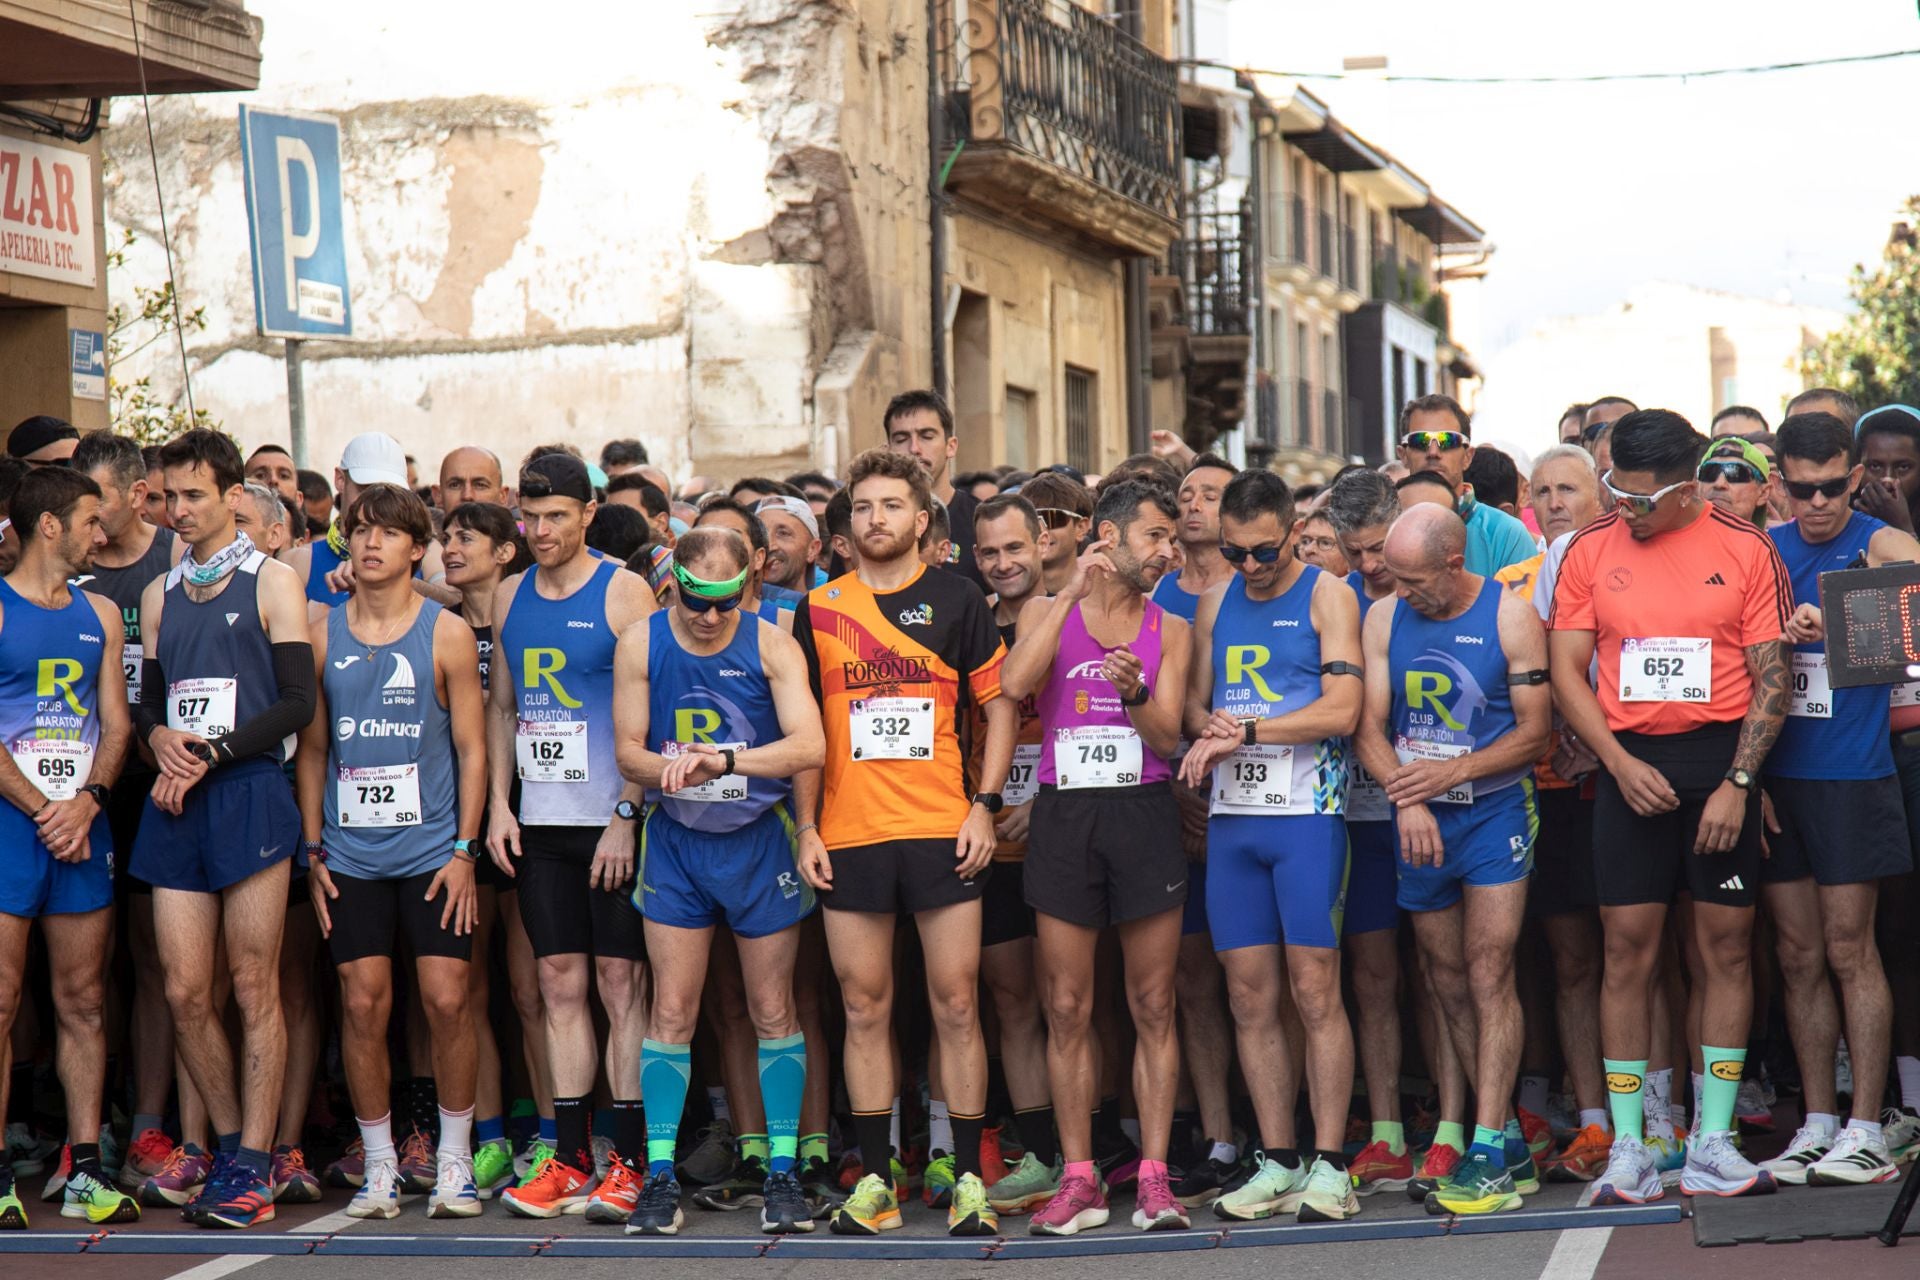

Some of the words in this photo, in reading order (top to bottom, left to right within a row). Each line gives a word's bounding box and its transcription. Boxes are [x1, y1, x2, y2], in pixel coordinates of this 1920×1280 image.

[0, 150, 80, 236] ZAR
[276, 135, 320, 311] P
[0, 230, 51, 266] APELERIA
[843, 658, 930, 683] FORONDA
[1225, 644, 1284, 702] R
[1643, 657, 1685, 677] 652
[36, 658, 89, 717] R
[523, 647, 584, 709] R
[383, 697, 394, 705] La
[394, 696, 415, 706] Rioja
[524, 693, 550, 706] CLUB
[1225, 688, 1251, 701] CLUB
[1405, 670, 1466, 730] R
[1682, 687, 1706, 699] SDi
[37, 701, 62, 713] CLUB
[178, 697, 210, 718] 677
[524, 706, 572, 721] MARATÓN
[1225, 701, 1271, 715] MARATÓN
[1807, 702, 1828, 714] SDi
[35, 714, 83, 728] MARATÓN
[359, 718, 421, 739] Chiruca
[872, 717, 911, 736] 332
[1409, 712, 1435, 726] CLUB
[1409, 726, 1455, 742] MARATÓN
[530, 741, 564, 760] 162
[1078, 744, 1118, 764] 749
[38, 758, 75, 777] 695
[564, 769, 586, 780] SDi
[1009, 764, 1033, 783] 07
[1233, 762, 1268, 783] 133
[1116, 771, 1139, 784] SDi
[357, 784, 396, 805] 732
[722, 788, 744, 800] SDi
[1265, 793, 1287, 805] SDi
[1446, 790, 1469, 802] SDi
[395, 811, 418, 823] SDi
